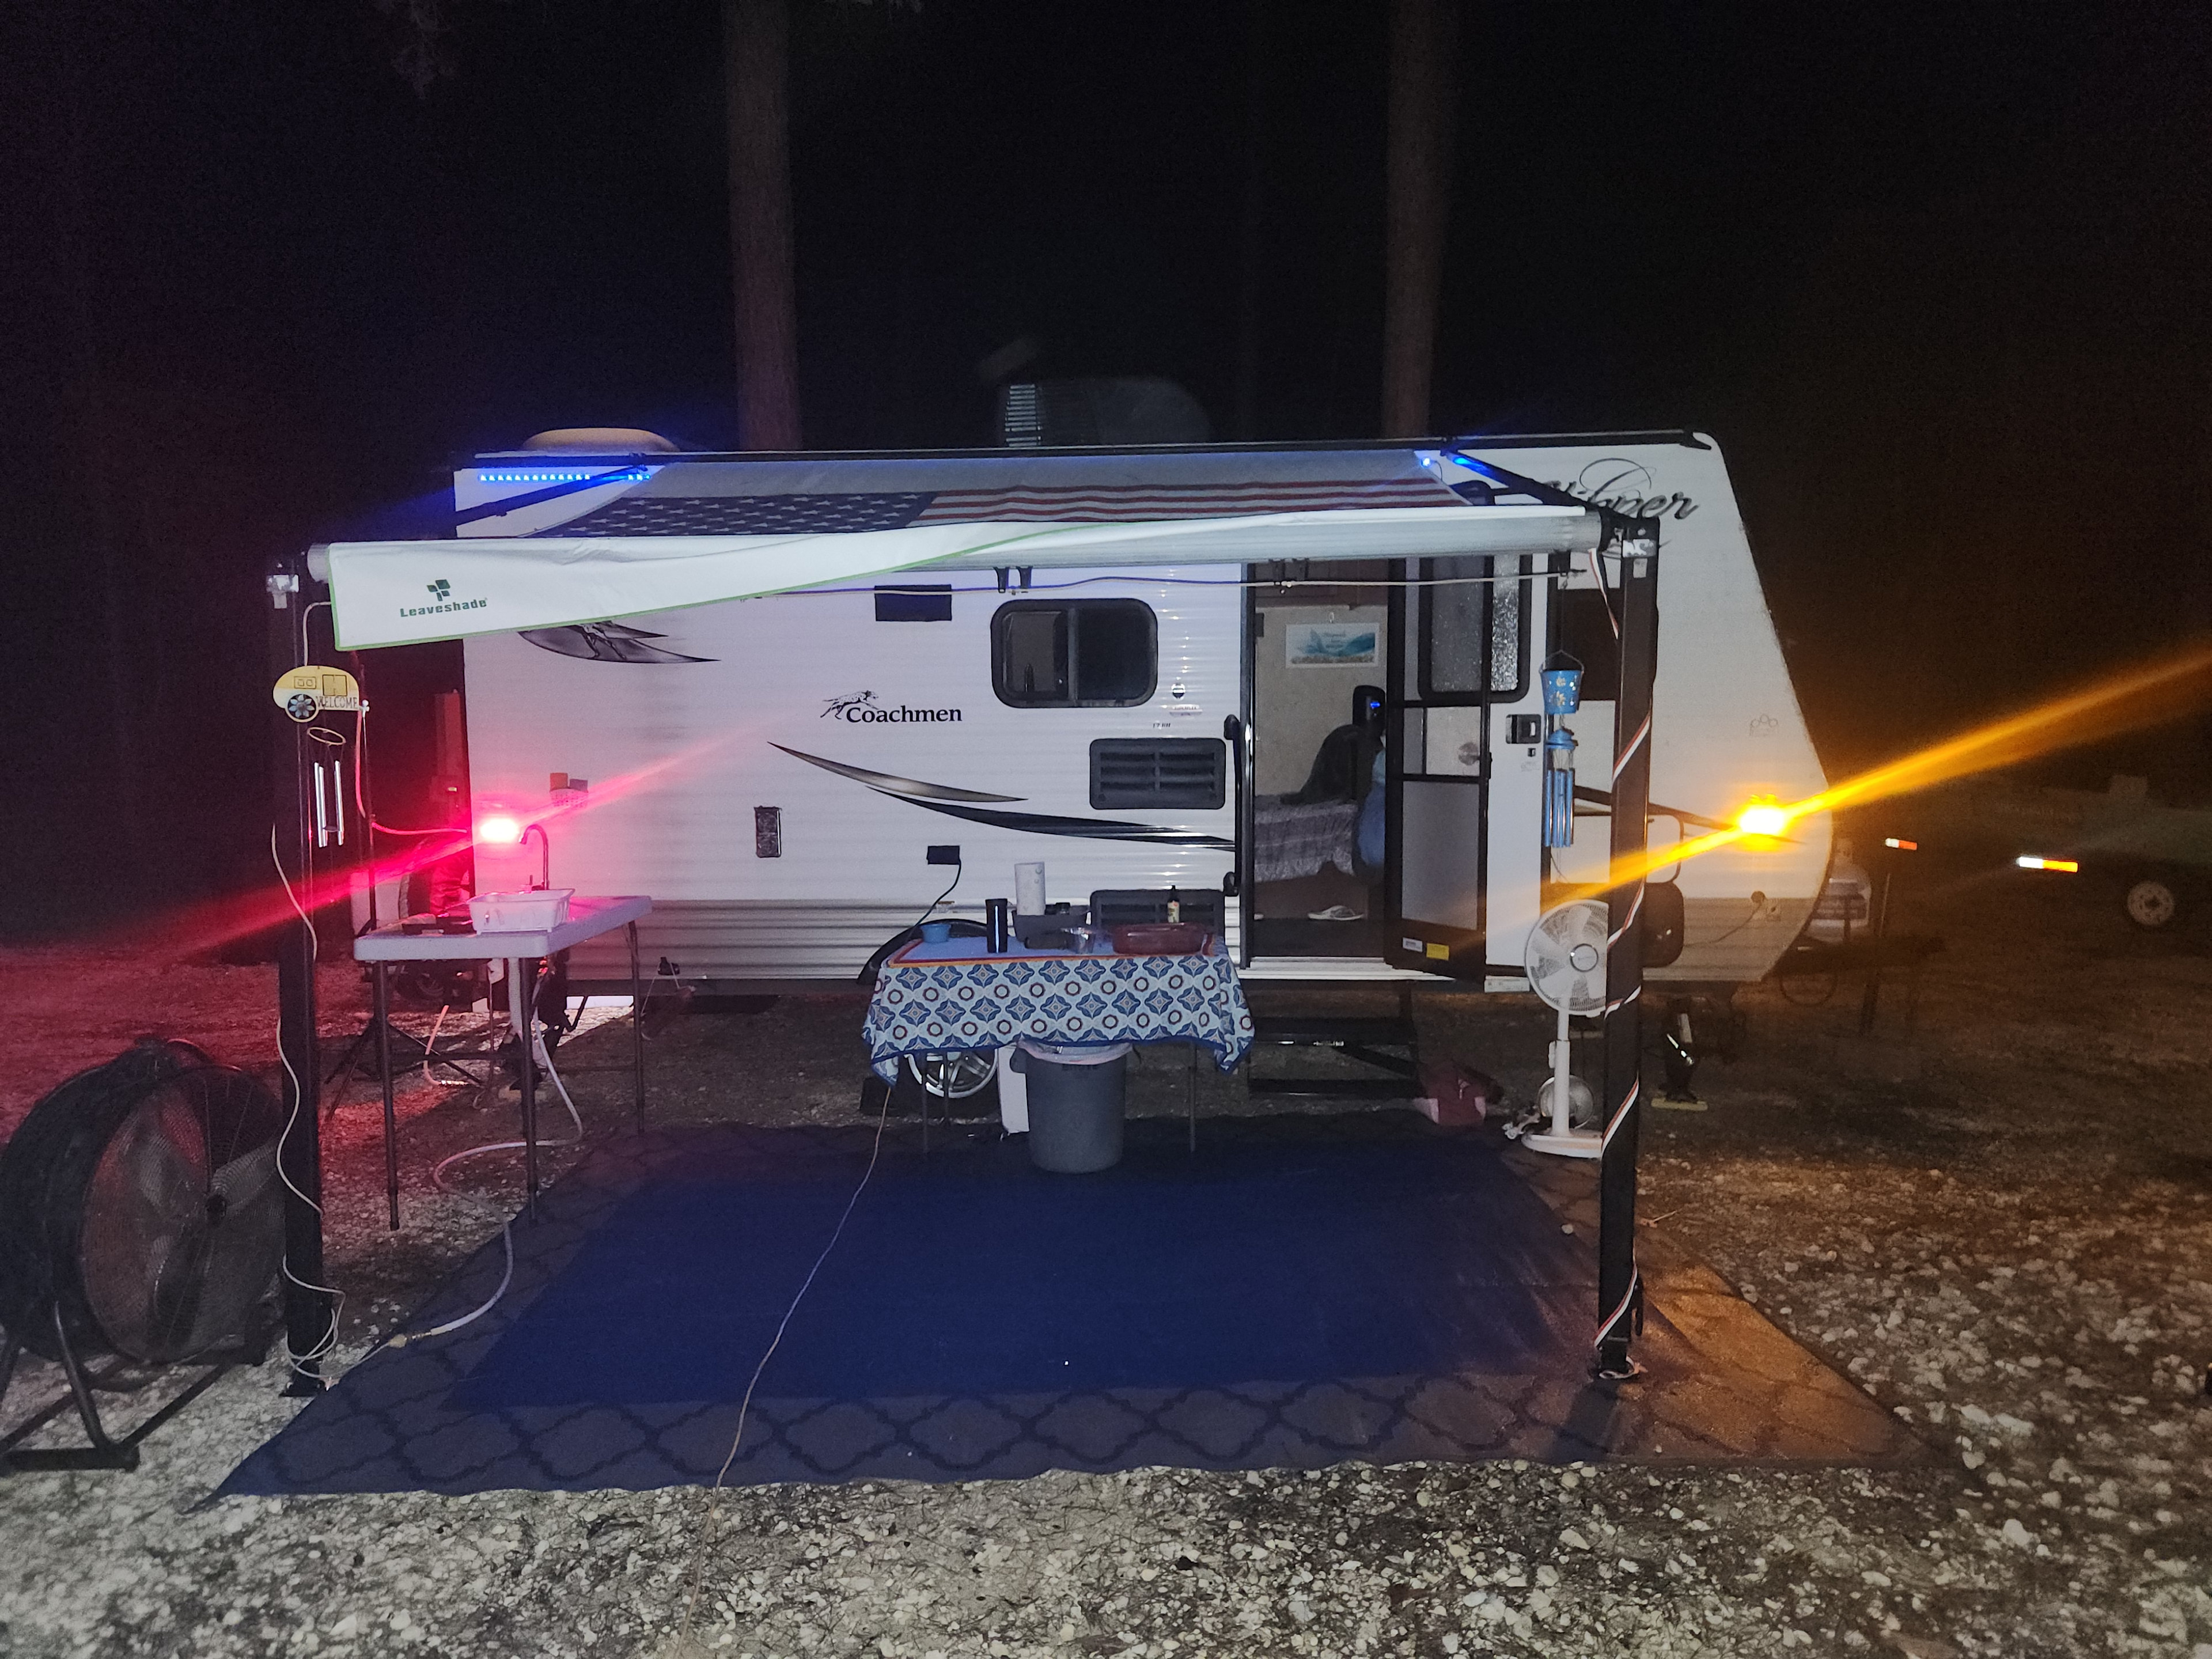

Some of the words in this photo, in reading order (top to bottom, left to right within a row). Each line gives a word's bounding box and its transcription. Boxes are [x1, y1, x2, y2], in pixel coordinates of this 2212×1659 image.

[400, 599, 487, 618] Leaveshade
[316, 695, 358, 709] WELCOME
[846, 705, 963, 723] Coachmen
